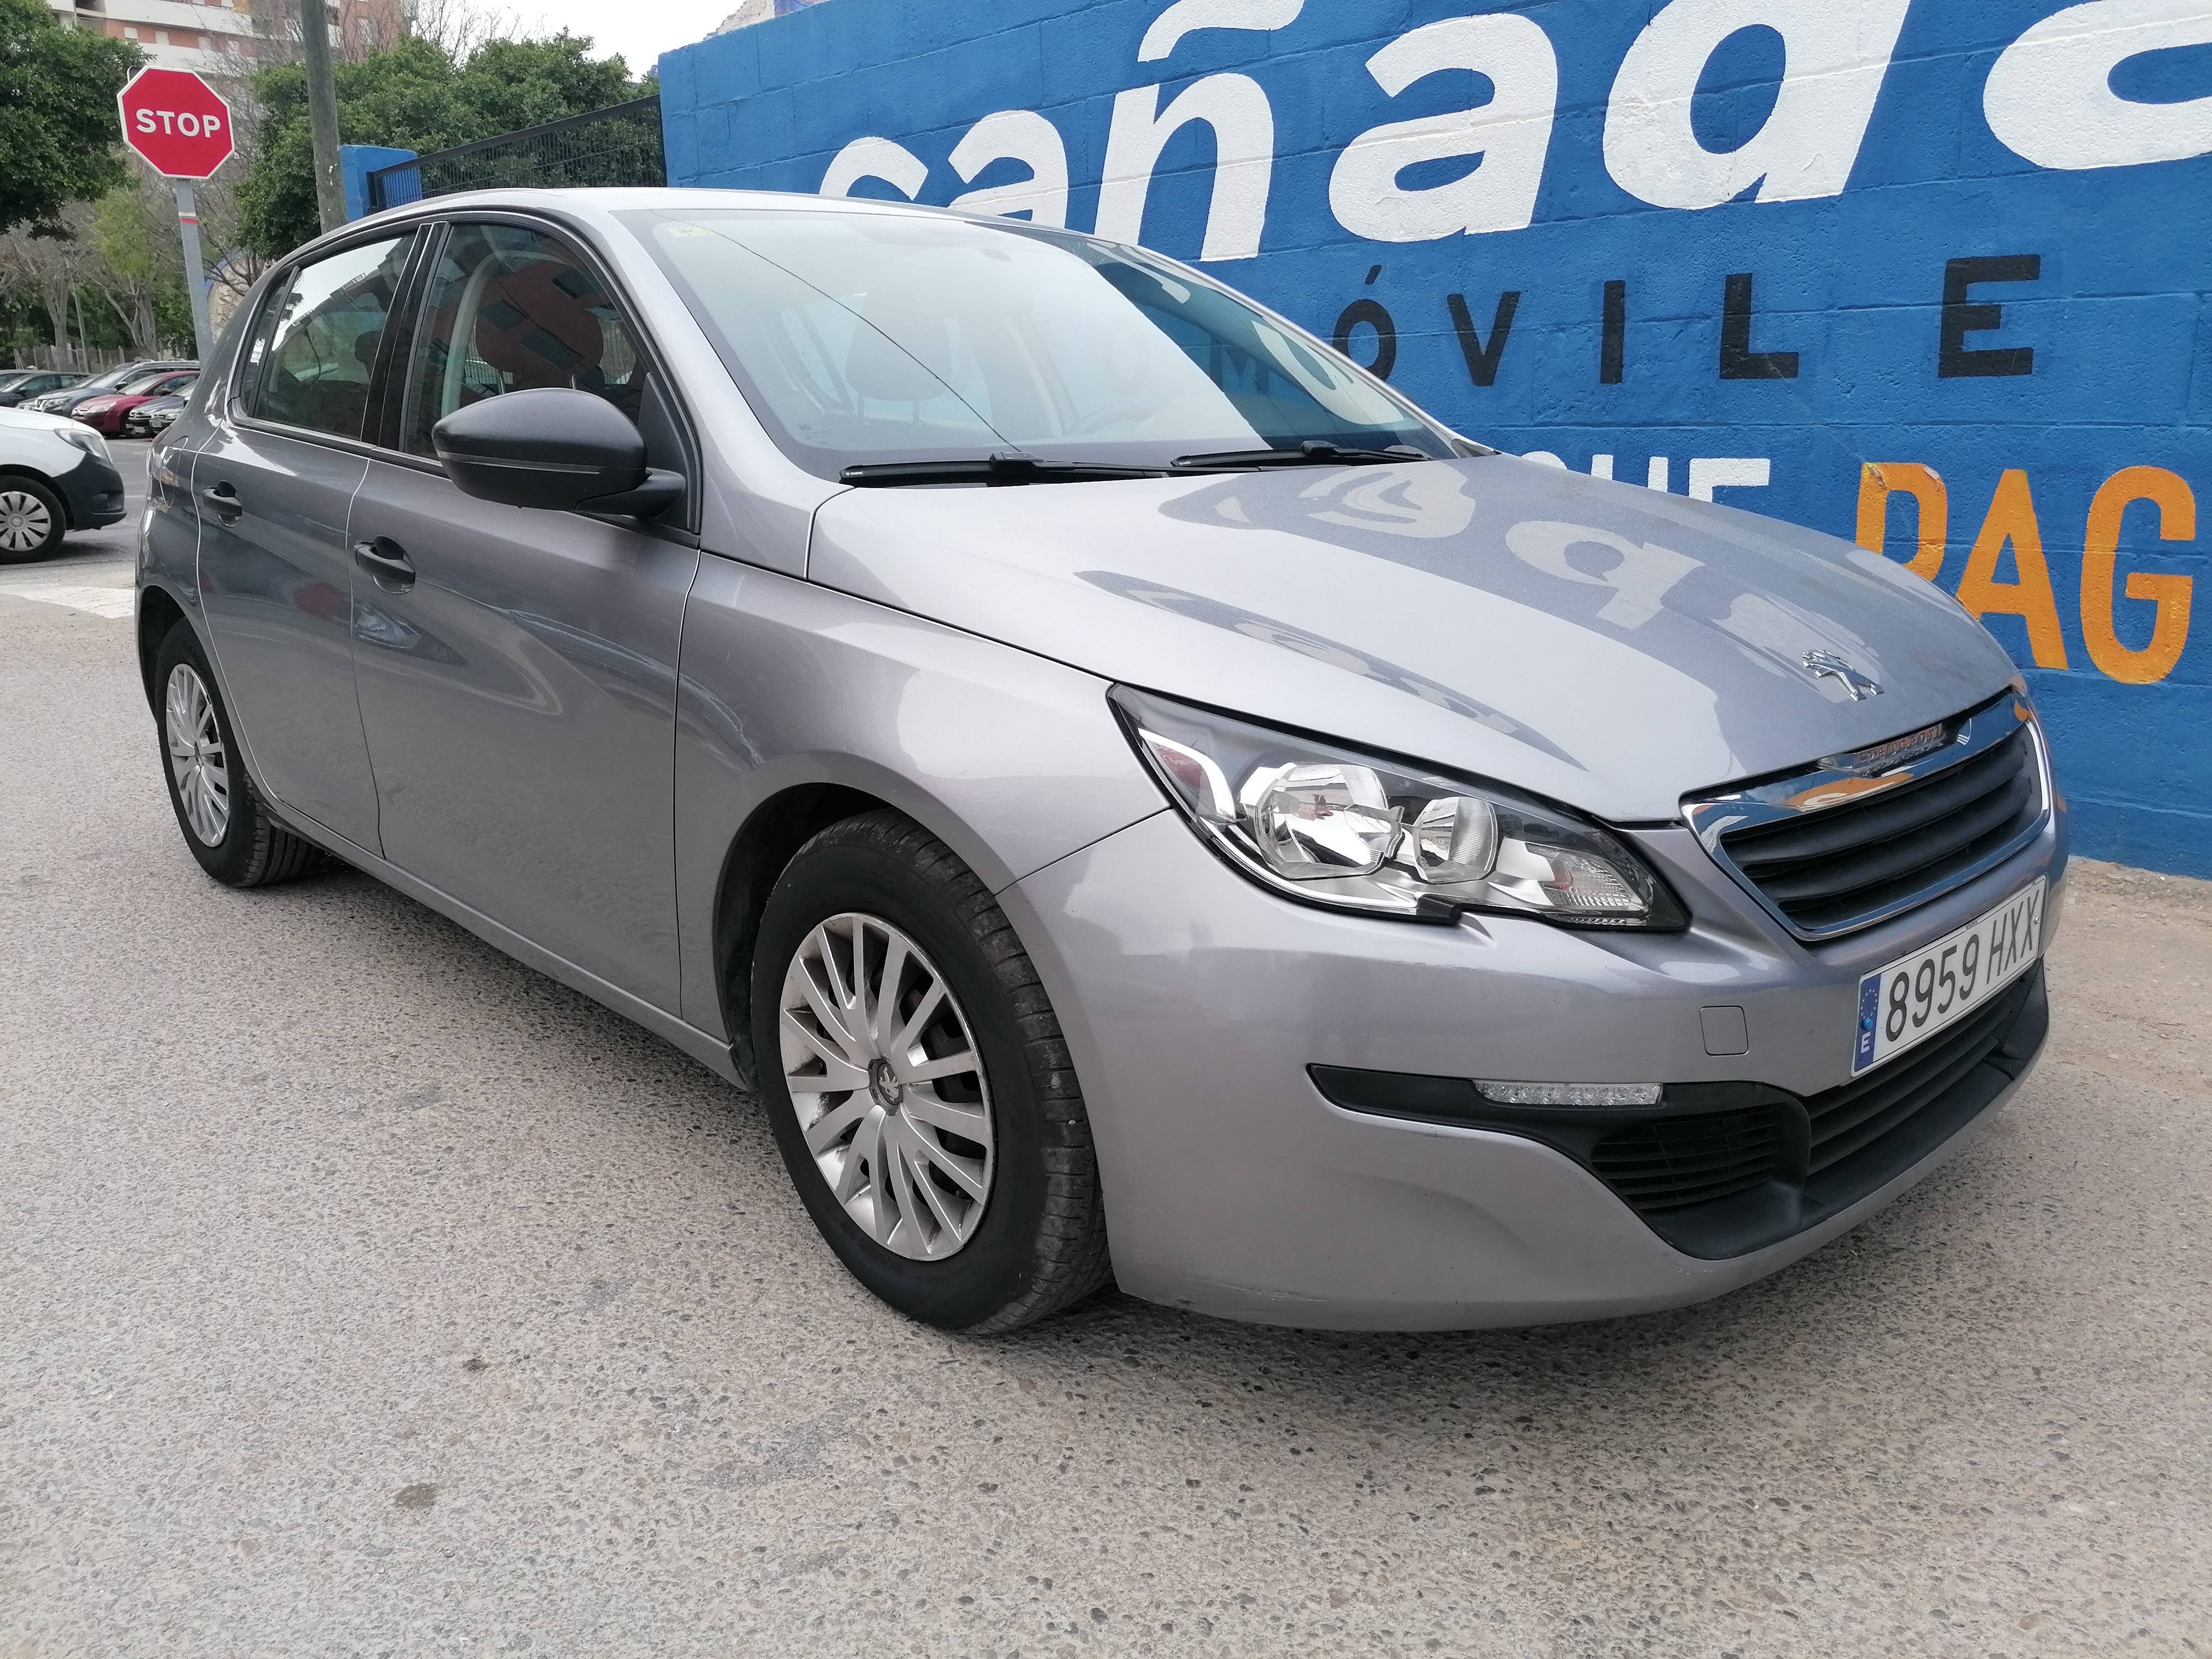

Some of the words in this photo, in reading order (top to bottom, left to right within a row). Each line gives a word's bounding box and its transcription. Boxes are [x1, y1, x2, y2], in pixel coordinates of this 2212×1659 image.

[136, 108, 221, 138] STOP
[1885, 933, 1980, 1042] 8959
[1986, 889, 2040, 985] HXX
[1860, 1031, 1871, 1054] E
